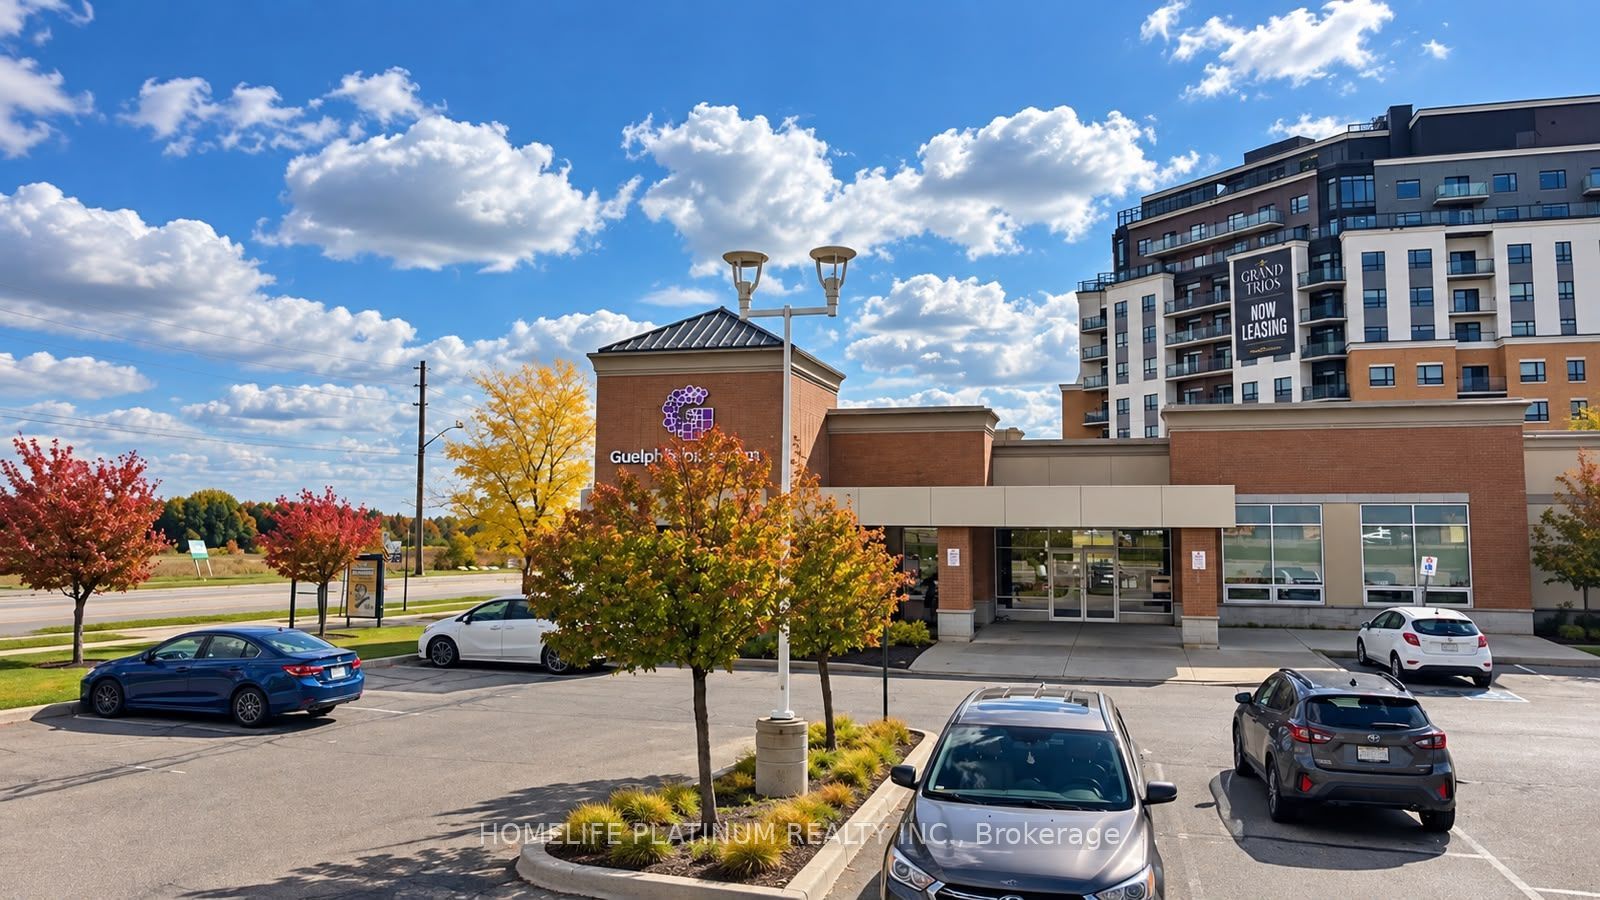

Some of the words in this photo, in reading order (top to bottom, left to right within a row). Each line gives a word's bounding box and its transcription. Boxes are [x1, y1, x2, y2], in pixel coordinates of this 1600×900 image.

[1241, 264, 1283, 283] GRAND
[1246, 278, 1281, 295] TRIOS
[1251, 301, 1276, 321] NOW
[1242, 318, 1287, 341] LEASING
